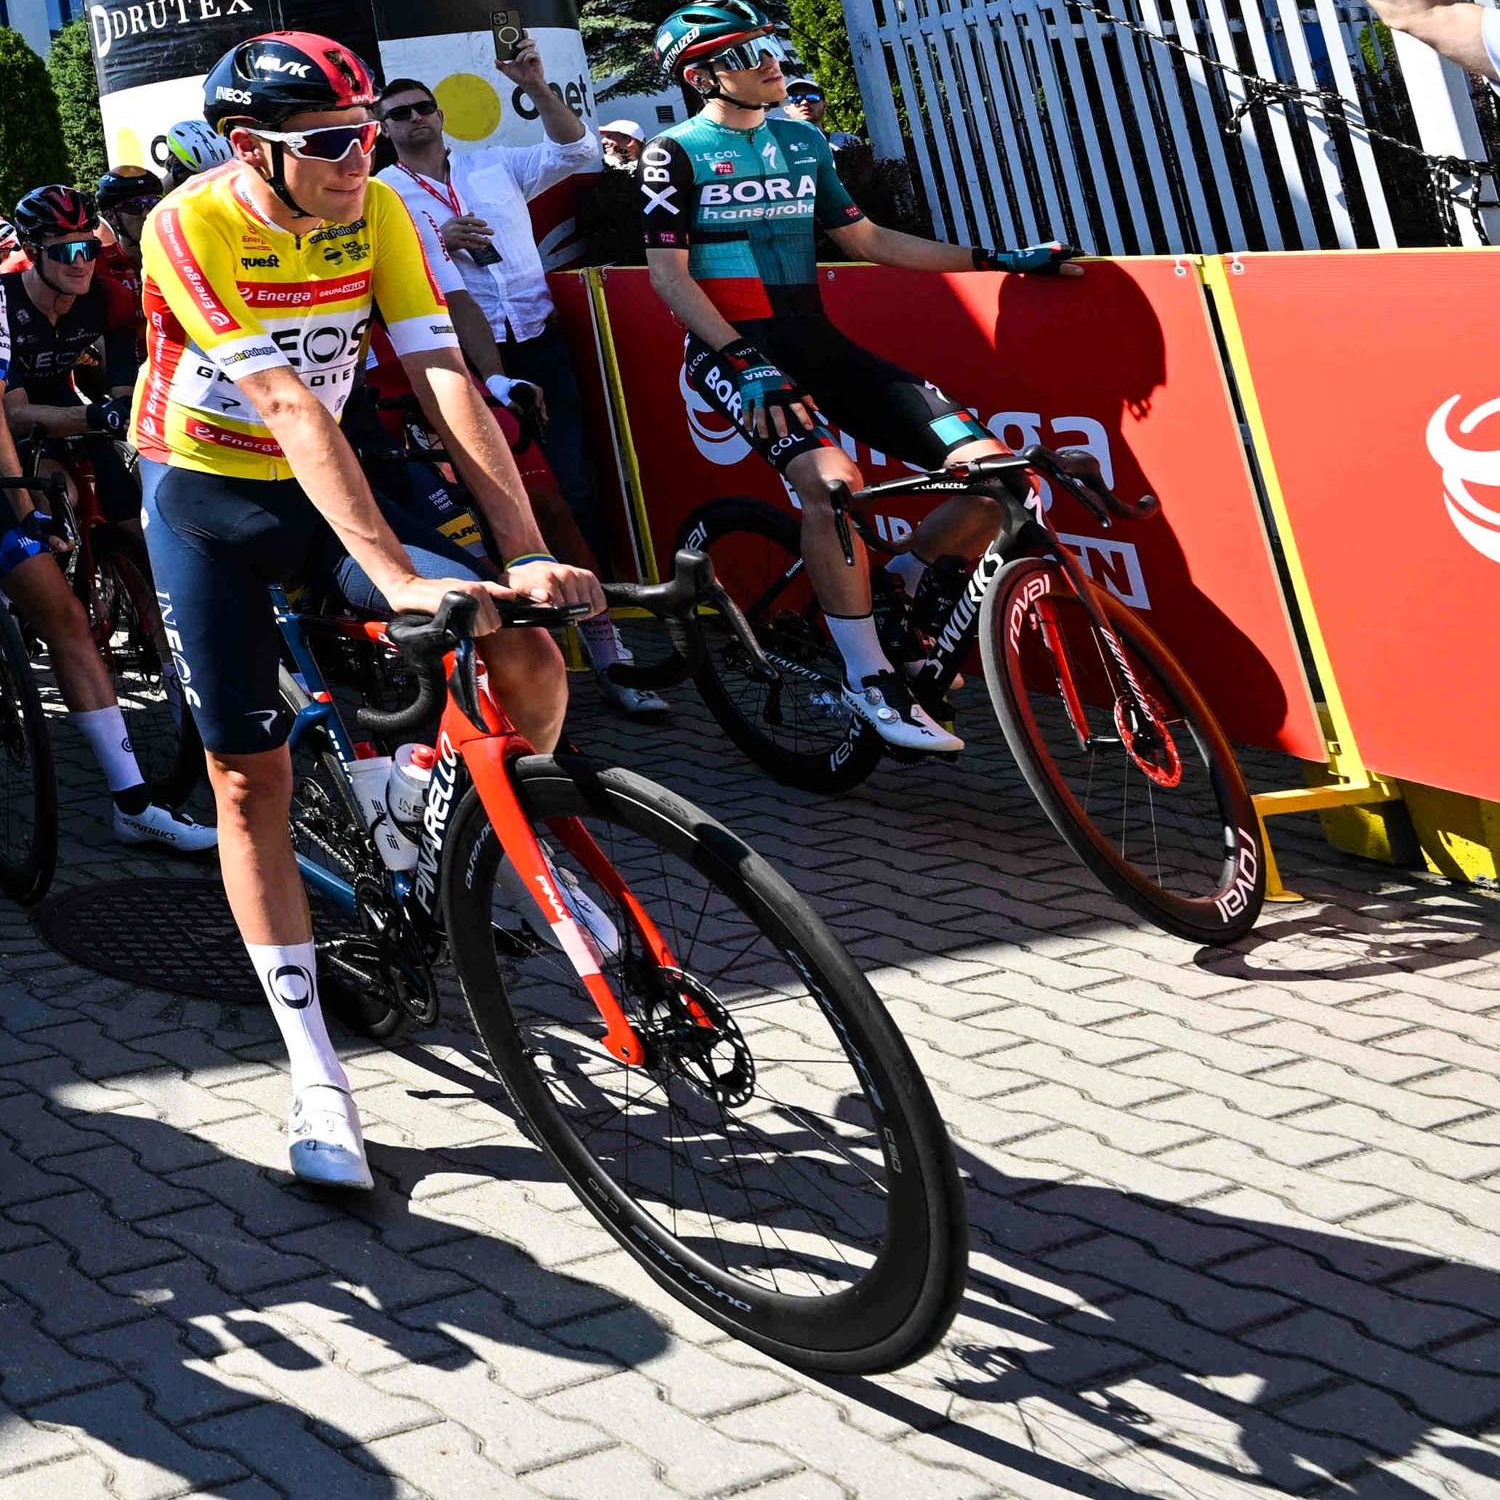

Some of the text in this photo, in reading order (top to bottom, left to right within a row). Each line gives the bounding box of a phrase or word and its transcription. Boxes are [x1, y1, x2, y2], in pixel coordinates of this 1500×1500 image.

[255, 54, 312, 79] KASK
[215, 85, 252, 105] INEOS
[695, 149, 742, 162] LE COL
[701, 174, 817, 206] BORA
[703, 201, 816, 221] hansgrohe
[240, 253, 281, 270] quest
[257, 289, 312, 304] Energa
[319, 287, 343, 298] GRUPA
[924, 540, 1004, 681] S-WORKS
[414, 732, 462, 916] PINARELLO
[1213, 827, 1258, 924] roval
